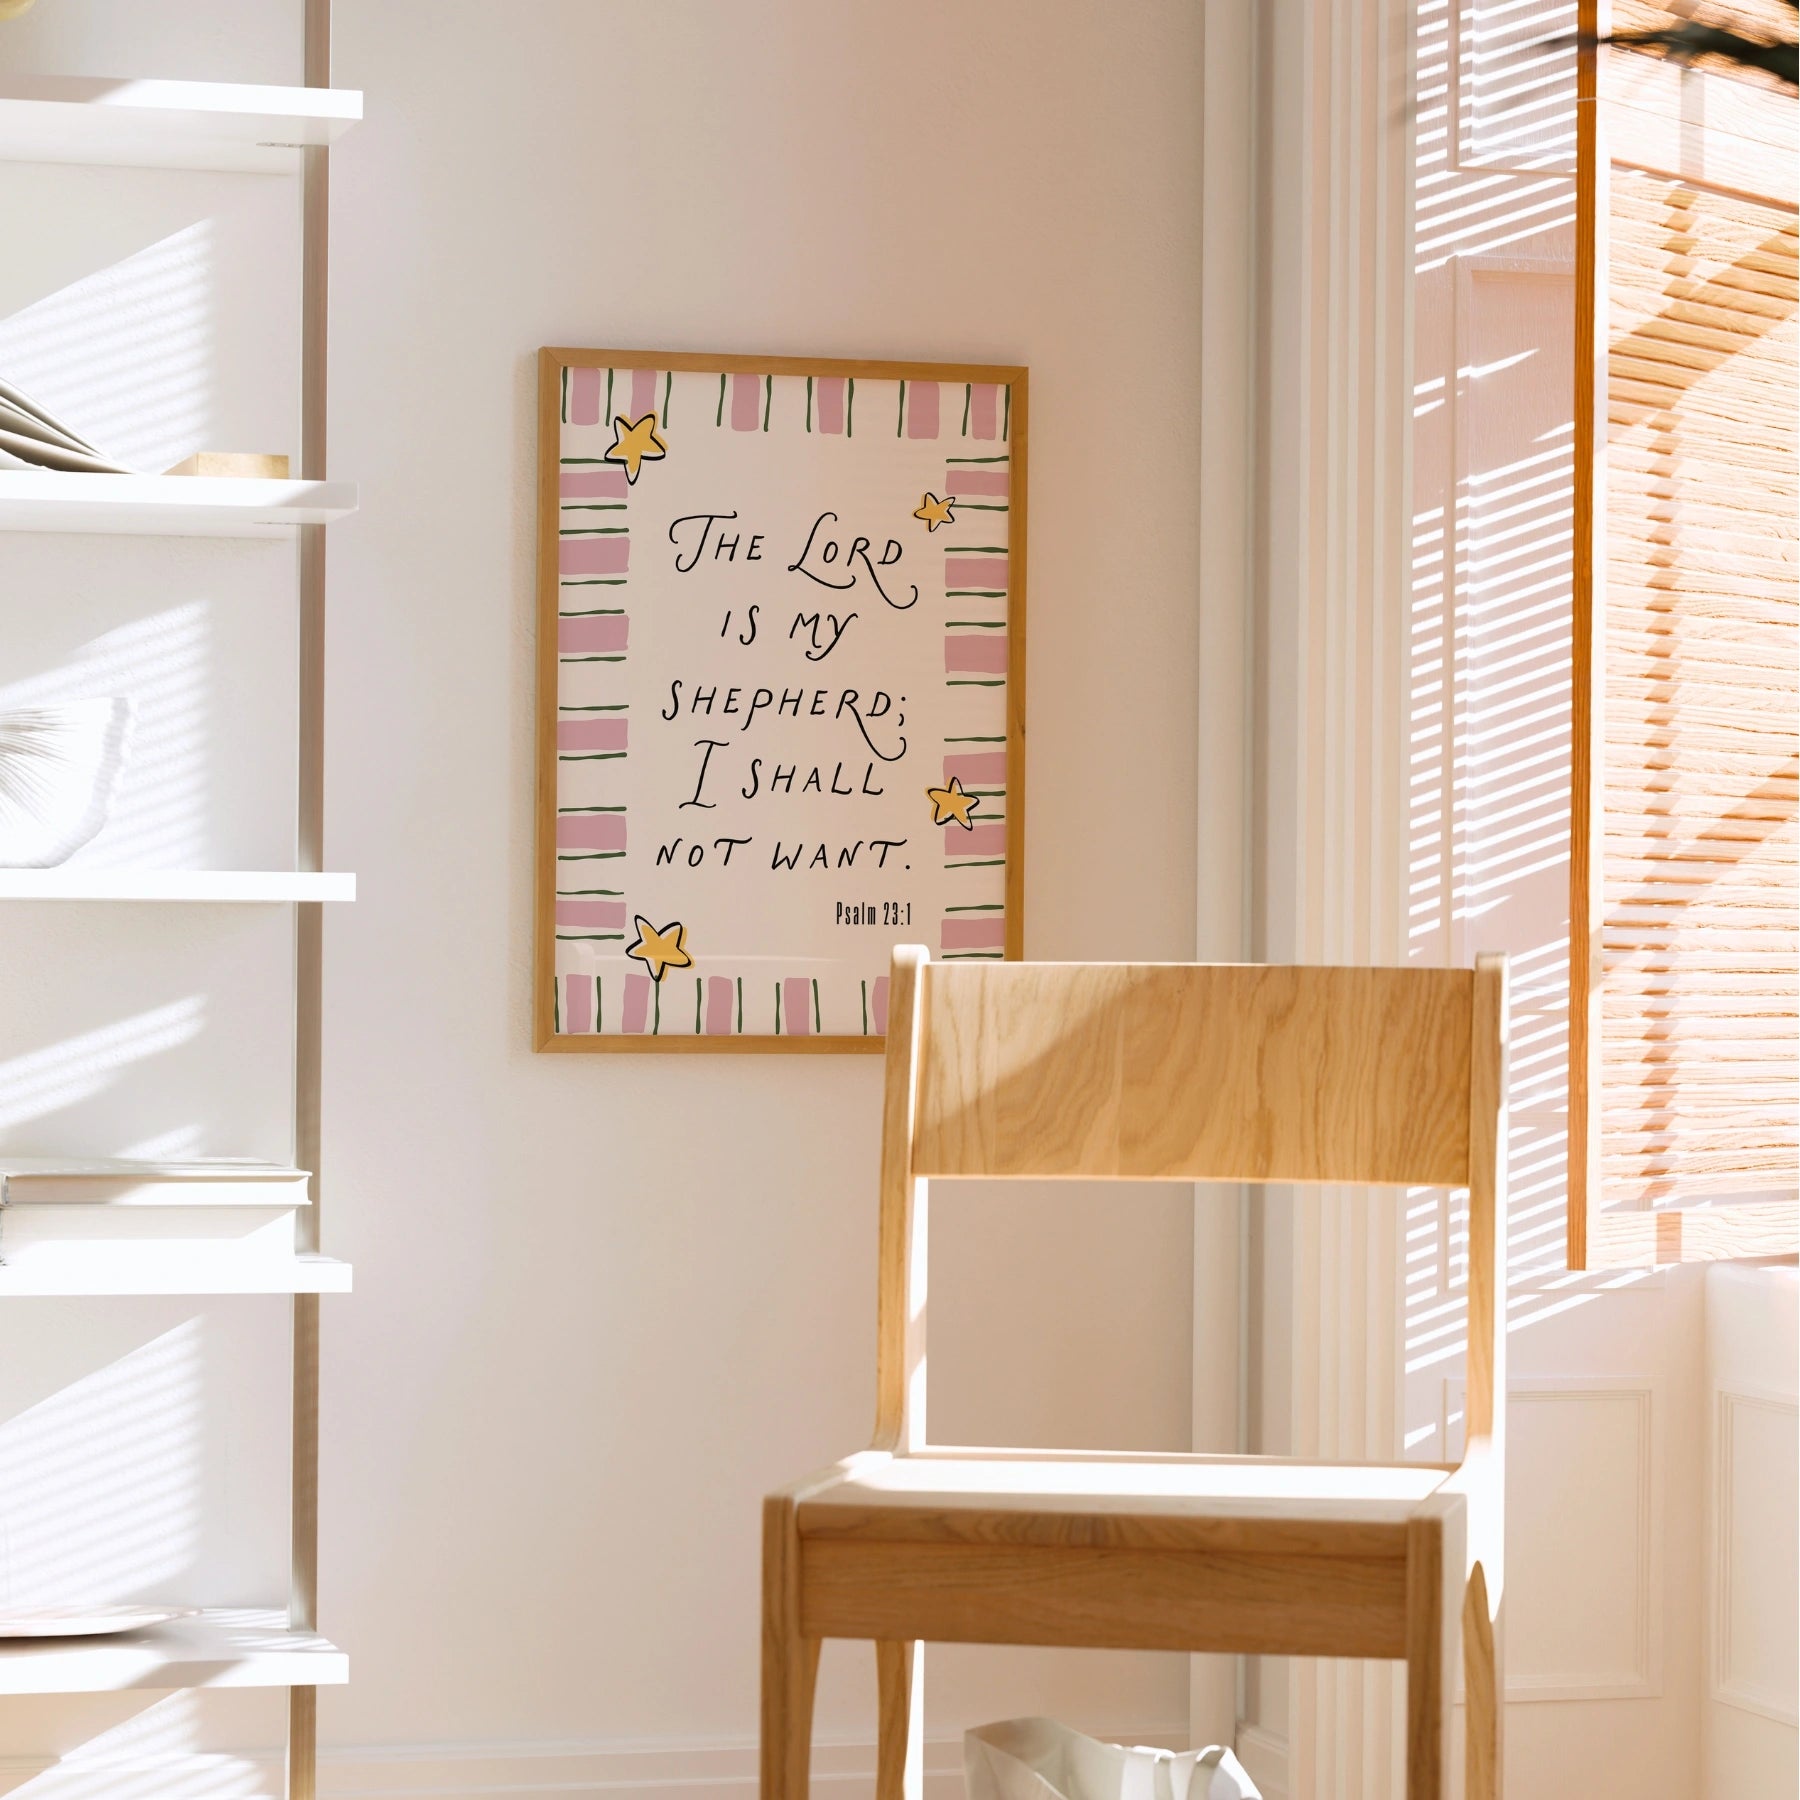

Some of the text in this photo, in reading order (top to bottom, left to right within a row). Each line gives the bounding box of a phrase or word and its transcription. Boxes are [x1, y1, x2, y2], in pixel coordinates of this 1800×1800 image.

[669, 511, 918, 610] THE LORD
[720, 604, 859, 662] IS MY
[662, 679, 907, 762] SHEPHERD;
[679, 740, 884, 809] I SHALL
[655, 837, 911, 871] NOT WANT.
[836, 901, 911, 926] Psalm 23:1
